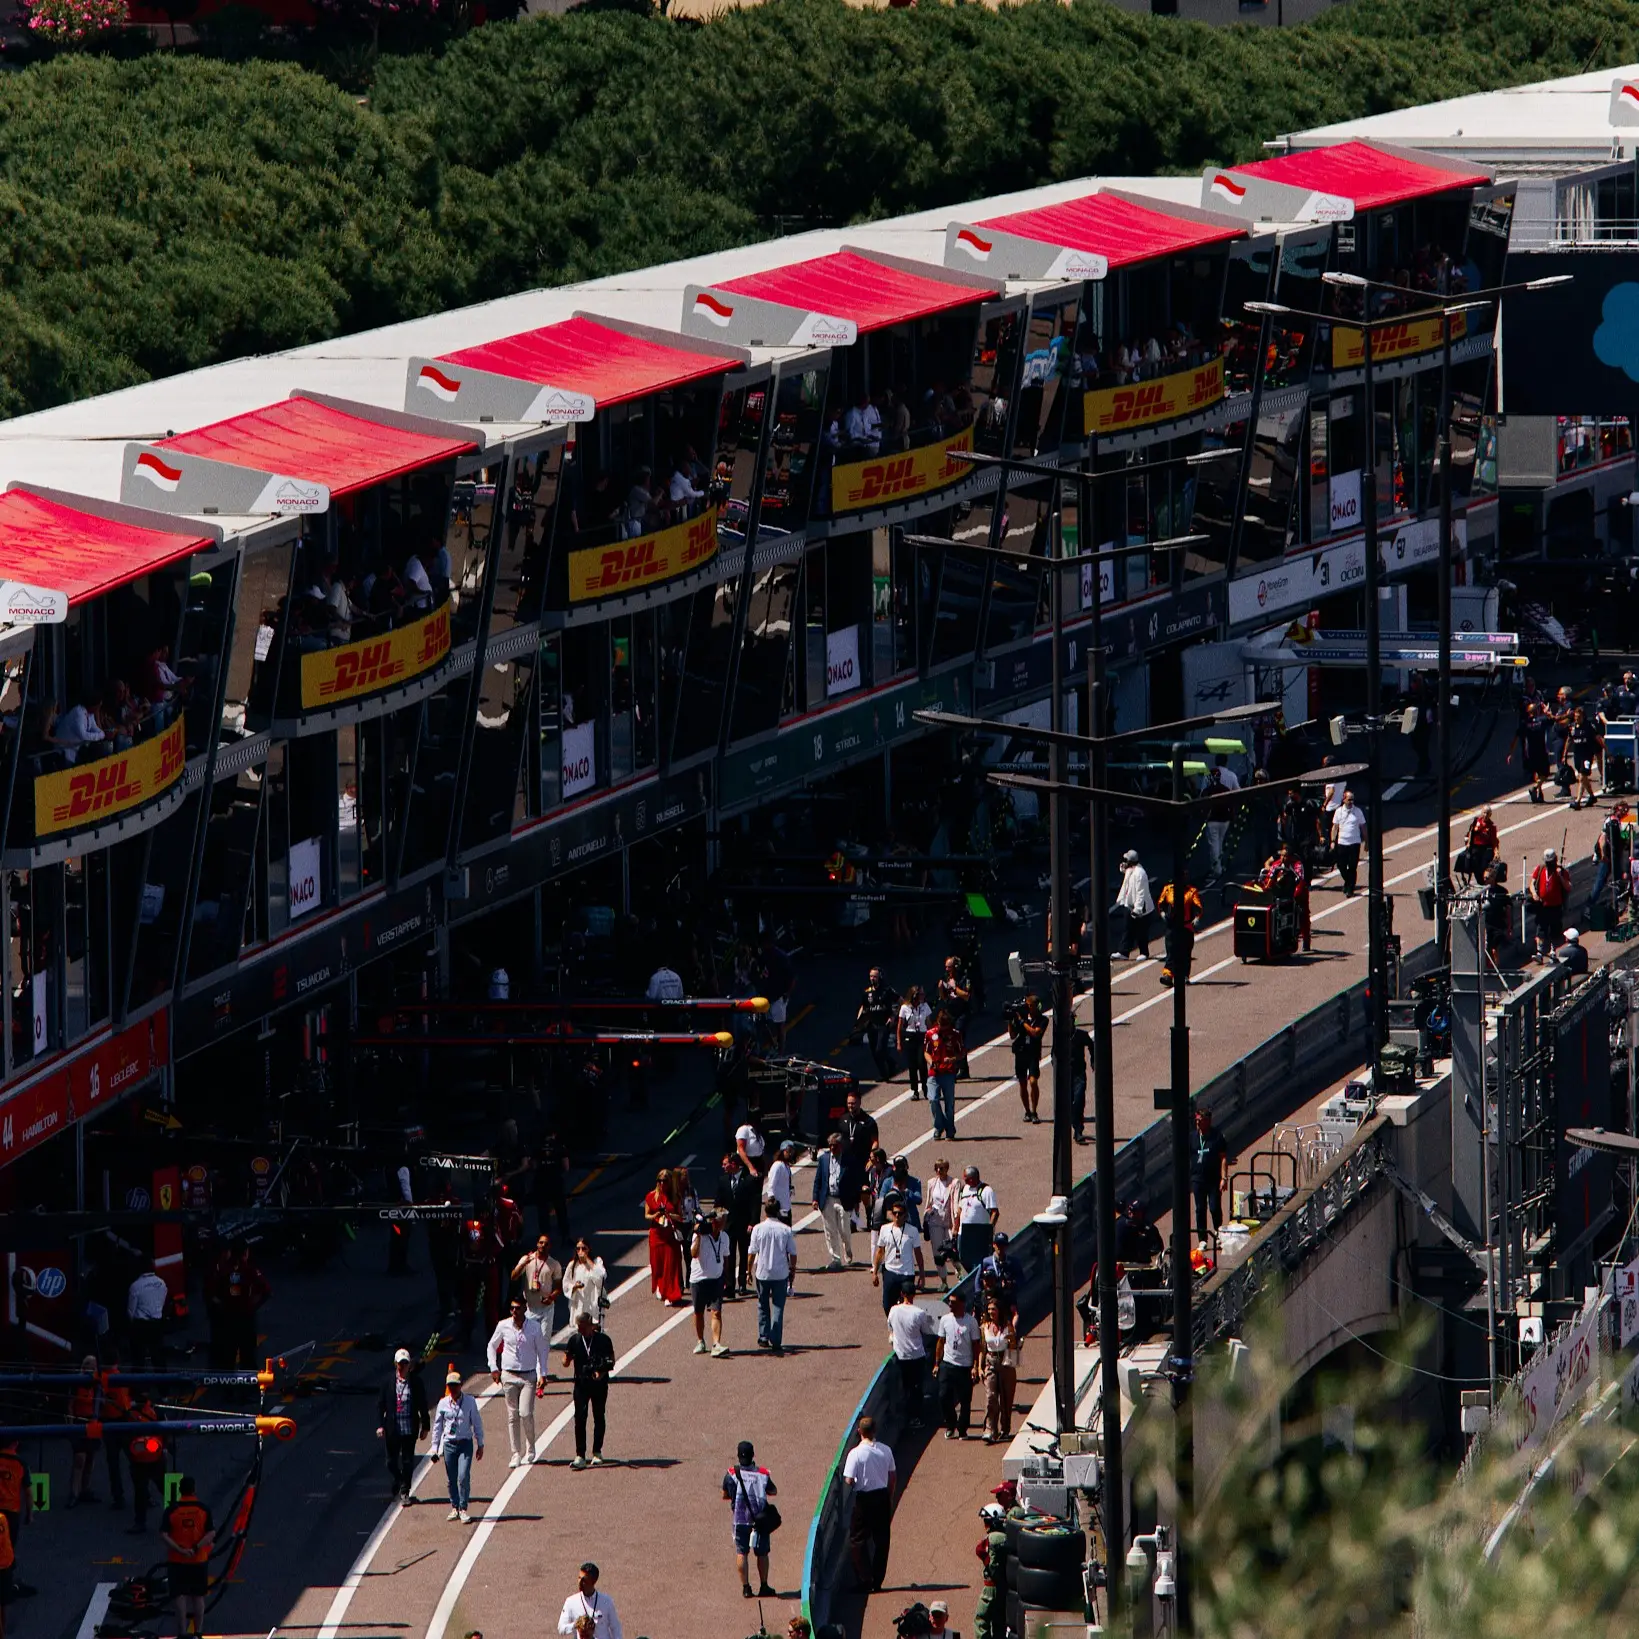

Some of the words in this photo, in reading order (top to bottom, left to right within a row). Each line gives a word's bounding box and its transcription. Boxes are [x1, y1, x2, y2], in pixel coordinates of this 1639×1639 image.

[1112, 384, 1168, 423] DHL
[1193, 366, 1222, 404] DHL
[861, 457, 918, 499] DHL
[600, 540, 659, 587] DHL
[688, 517, 716, 562] DHL
[1321, 562, 1330, 586] 31
[1341, 565, 1364, 582] OCON
[1149, 612, 1158, 641] 43
[1167, 614, 1201, 635] COLAPINTO
[333, 641, 394, 692] DHL
[423, 612, 449, 663] DHL
[896, 701, 905, 729] 14
[813, 734, 823, 761] 18
[835, 735, 861, 752] STROLL
[69, 760, 131, 817] DHL
[160, 726, 184, 781] DHL
[656, 802, 686, 823] RUSSELL
[550, 837, 561, 867] 12
[567, 836, 607, 860] ANTONELLI
[377, 915, 422, 946] VERSTAPPEN
[296, 967, 330, 993] TSUNODA
[90, 1062, 100, 1100] 16
[109, 1060, 140, 1089] LECLERC
[3, 1114, 14, 1150] 44
[22, 1111, 58, 1142] HAMILTON
[455, 1163, 491, 1171] LGISTICS
[40, 1269, 62, 1295] hp
[204, 1377, 217, 1385] DP
[200, 1424, 213, 1432] DP
[215, 1423, 256, 1432] WORLD
